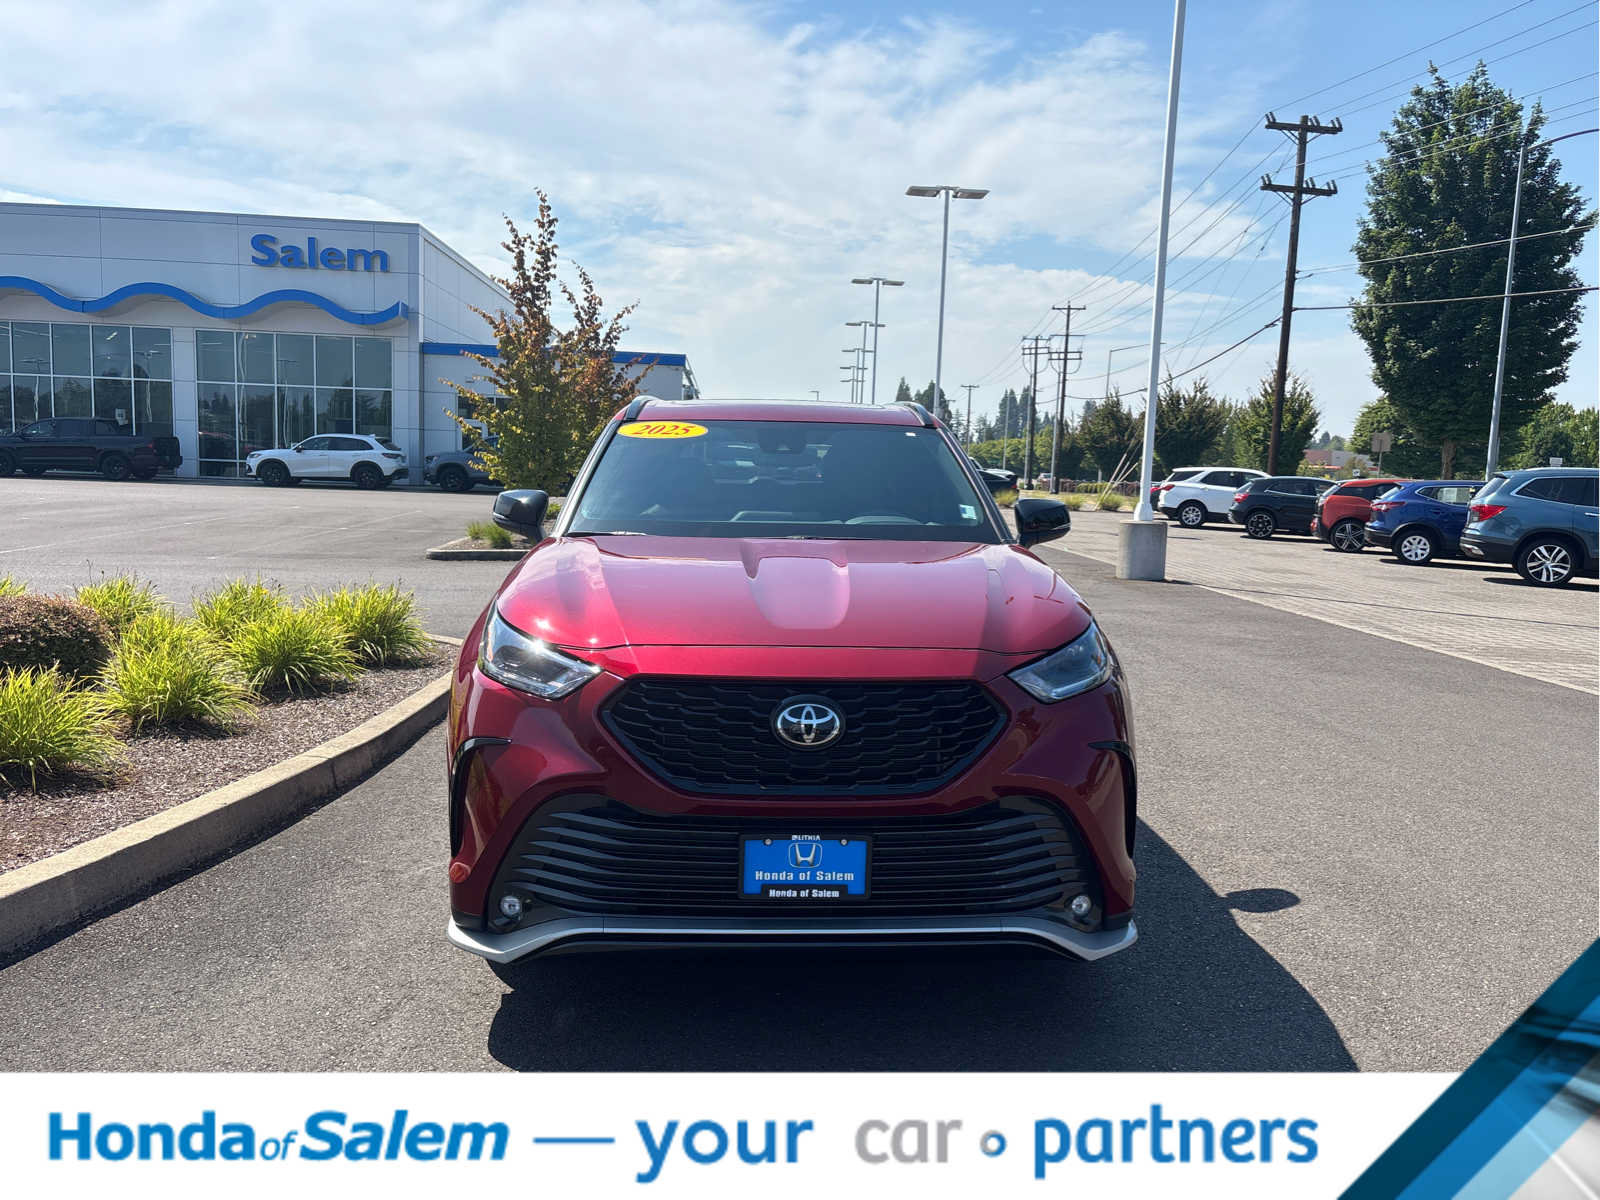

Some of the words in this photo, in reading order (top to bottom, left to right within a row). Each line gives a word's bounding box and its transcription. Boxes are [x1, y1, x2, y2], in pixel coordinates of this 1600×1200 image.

[250, 233, 389, 273] Salem
[632, 425, 696, 435] 2025
[755, 871, 794, 881] Honda
[799, 871, 811, 880] of
[816, 871, 855, 881] Salem
[769, 889, 797, 897] Honda
[800, 889, 809, 897] of
[812, 889, 840, 897] Salem
